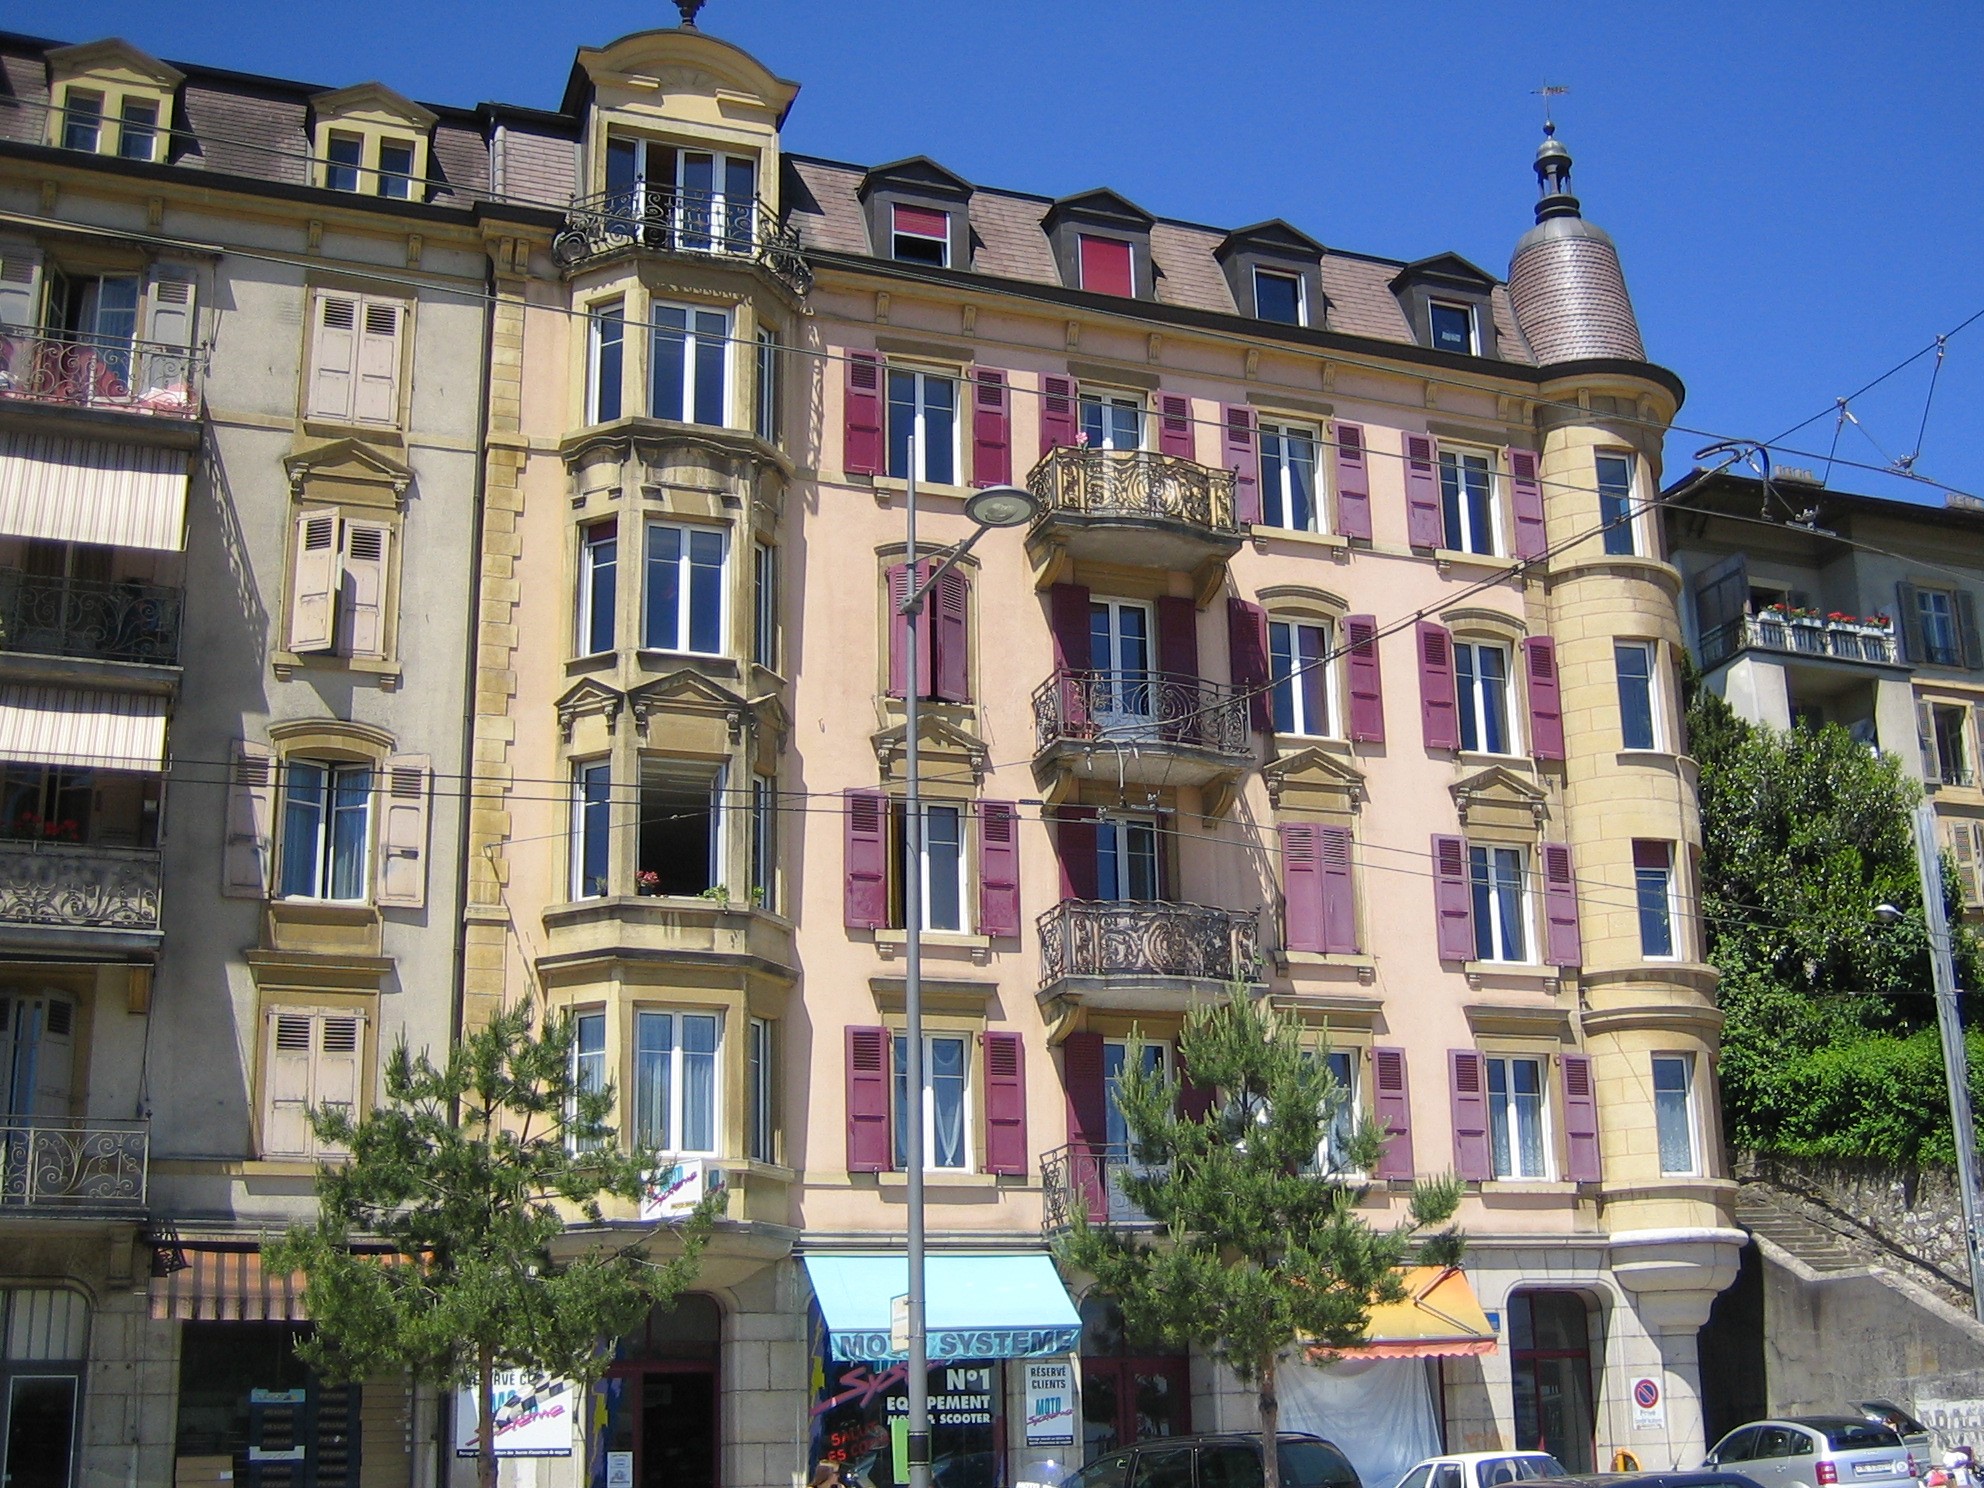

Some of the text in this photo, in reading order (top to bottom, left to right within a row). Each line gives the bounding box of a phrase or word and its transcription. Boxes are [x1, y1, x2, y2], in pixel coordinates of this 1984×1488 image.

[939, 1329, 1074, 1356] SYSTEME
[1031, 1379, 1066, 1390] CLIENTS
[886, 1395, 991, 1411] EQPEMENT
[1036, 1396, 1061, 1416] MOTO
[939, 1413, 991, 1424] SCOOTER
